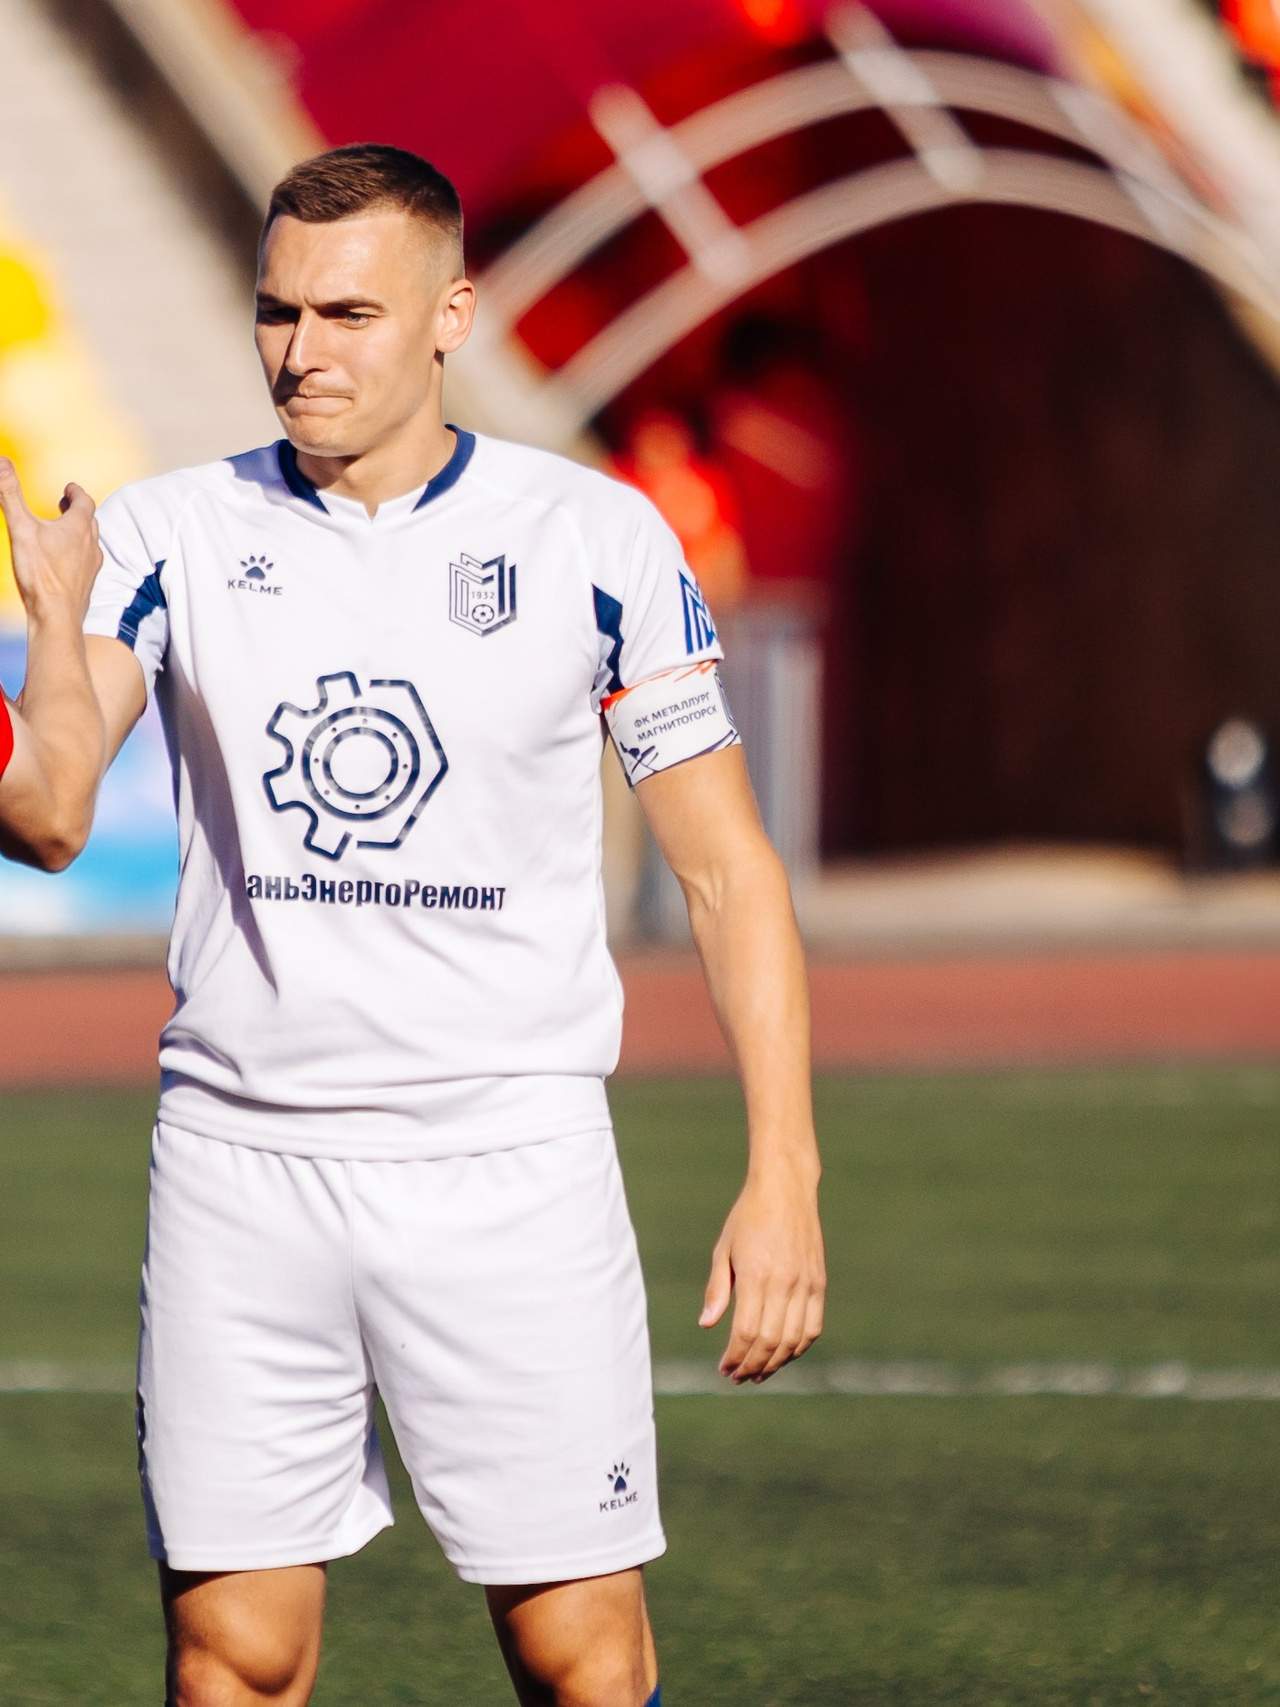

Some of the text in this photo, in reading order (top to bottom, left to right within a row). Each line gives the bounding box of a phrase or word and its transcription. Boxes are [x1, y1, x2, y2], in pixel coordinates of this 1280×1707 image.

[227, 579, 283, 596] KELME
[472, 590, 496, 600] 1932
[634, 691, 710, 728] ФК МЕТАЛЛУРГ
[637, 705, 718, 742] МАГНИТОГОРСК
[599, 1491, 638, 1513] KELME
